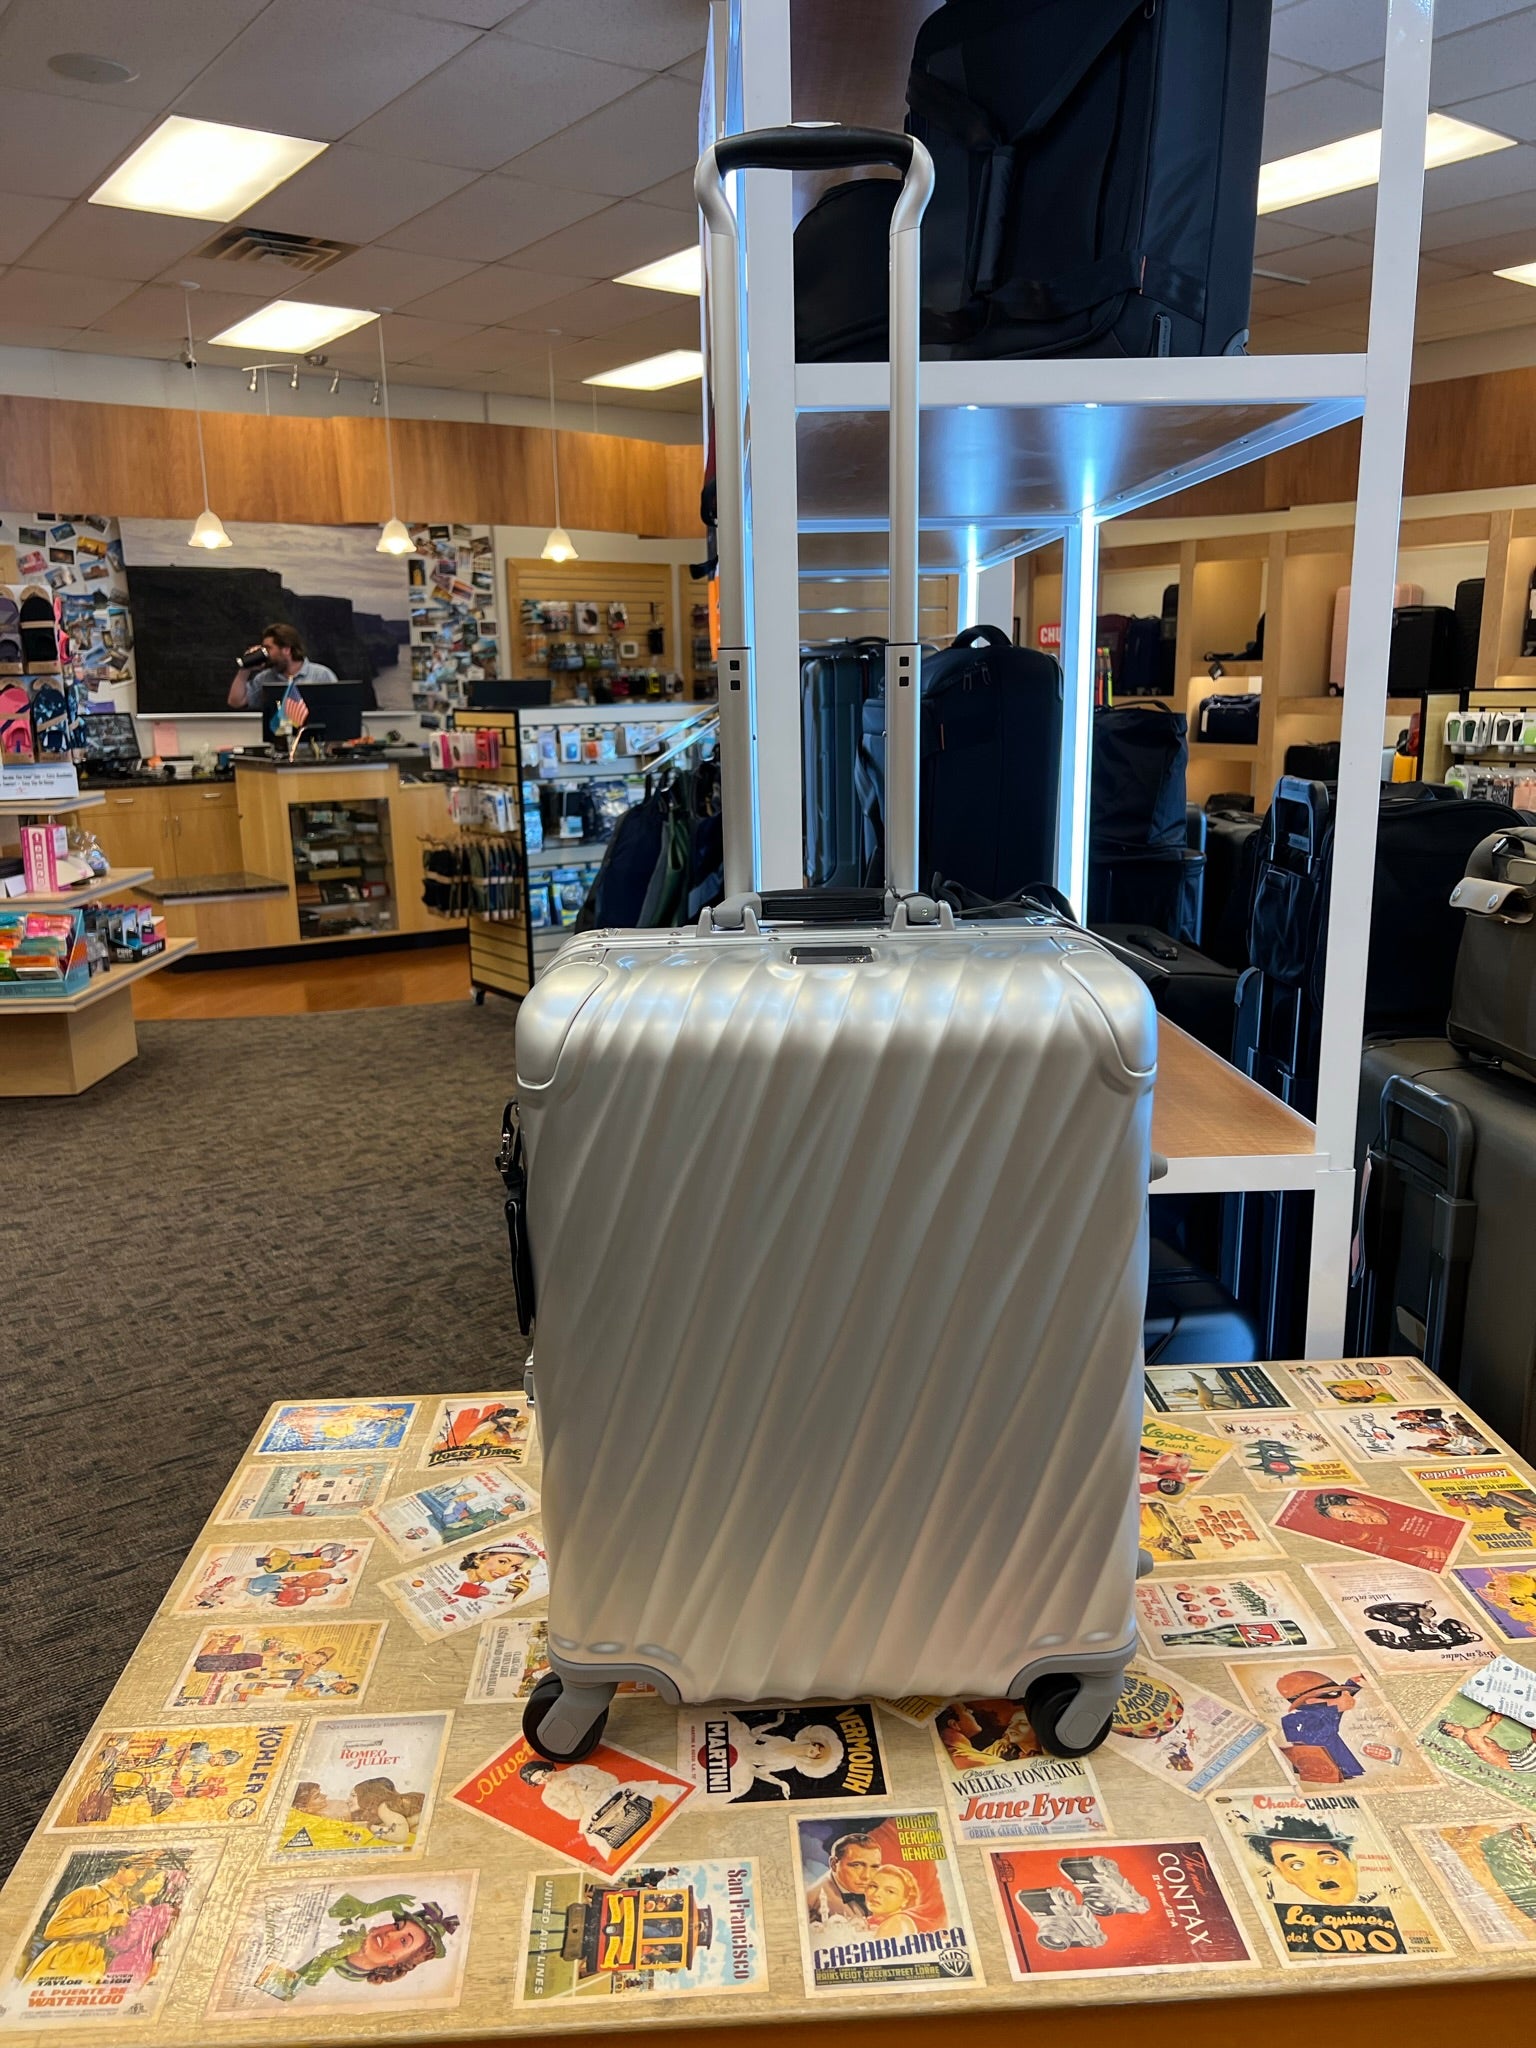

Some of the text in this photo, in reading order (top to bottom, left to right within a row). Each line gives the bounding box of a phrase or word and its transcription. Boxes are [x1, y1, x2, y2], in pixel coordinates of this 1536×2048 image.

[1142, 1423, 1200, 1442] Vespa
[1418, 1467, 1468, 1480] Holiday
[1463, 1469, 1507, 1480] Roman
[1473, 1531, 1533, 1541] HEPBURN
[1485, 1539, 1534, 1549] AUDREY
[1440, 1652, 1467, 1661] Value
[1125, 1683, 1154, 1712] MONDE
[1128, 1710, 1151, 1724] 80
[1149, 1690, 1170, 1717] JOURS
[242, 1725, 287, 1795] KOHLER
[339, 1749, 388, 1760] ROMEO
[707, 1722, 730, 1793] MARTINI
[835, 1707, 876, 1795] VERMOUTH
[353, 1756, 401, 1770] JULIET
[952, 1760, 1086, 1797] WELLES FONTAINE
[959, 1792, 1096, 1825] Jane Eyre
[1252, 1794, 1360, 1811] Charlie CHAPLIN
[896, 1814, 939, 1830] BOGART
[898, 1829, 943, 1846] BERGMAN
[901, 1845, 947, 1862] HENREID
[541, 1880, 554, 1925] UNITED
[1157, 1852, 1214, 1945] CONTAX
[727, 1869, 754, 1980] San Francisco
[1284, 1905, 1395, 1930] La quimera
[814, 1926, 967, 1970] CASABLANCA
[1286, 1929, 1398, 1953] del ORO
[534, 1954, 546, 1995] LINES
[863, 1967, 914, 1979] GREENSTREET
[915, 1965, 941, 1975] LORRE
[37, 1978, 132, 1987] TAYLOR LEIGH
[28, 1994, 125, 2008] WATERLOO
[51, 1987, 105, 1997] PUENTE
[109, 1987, 128, 1995] DE
